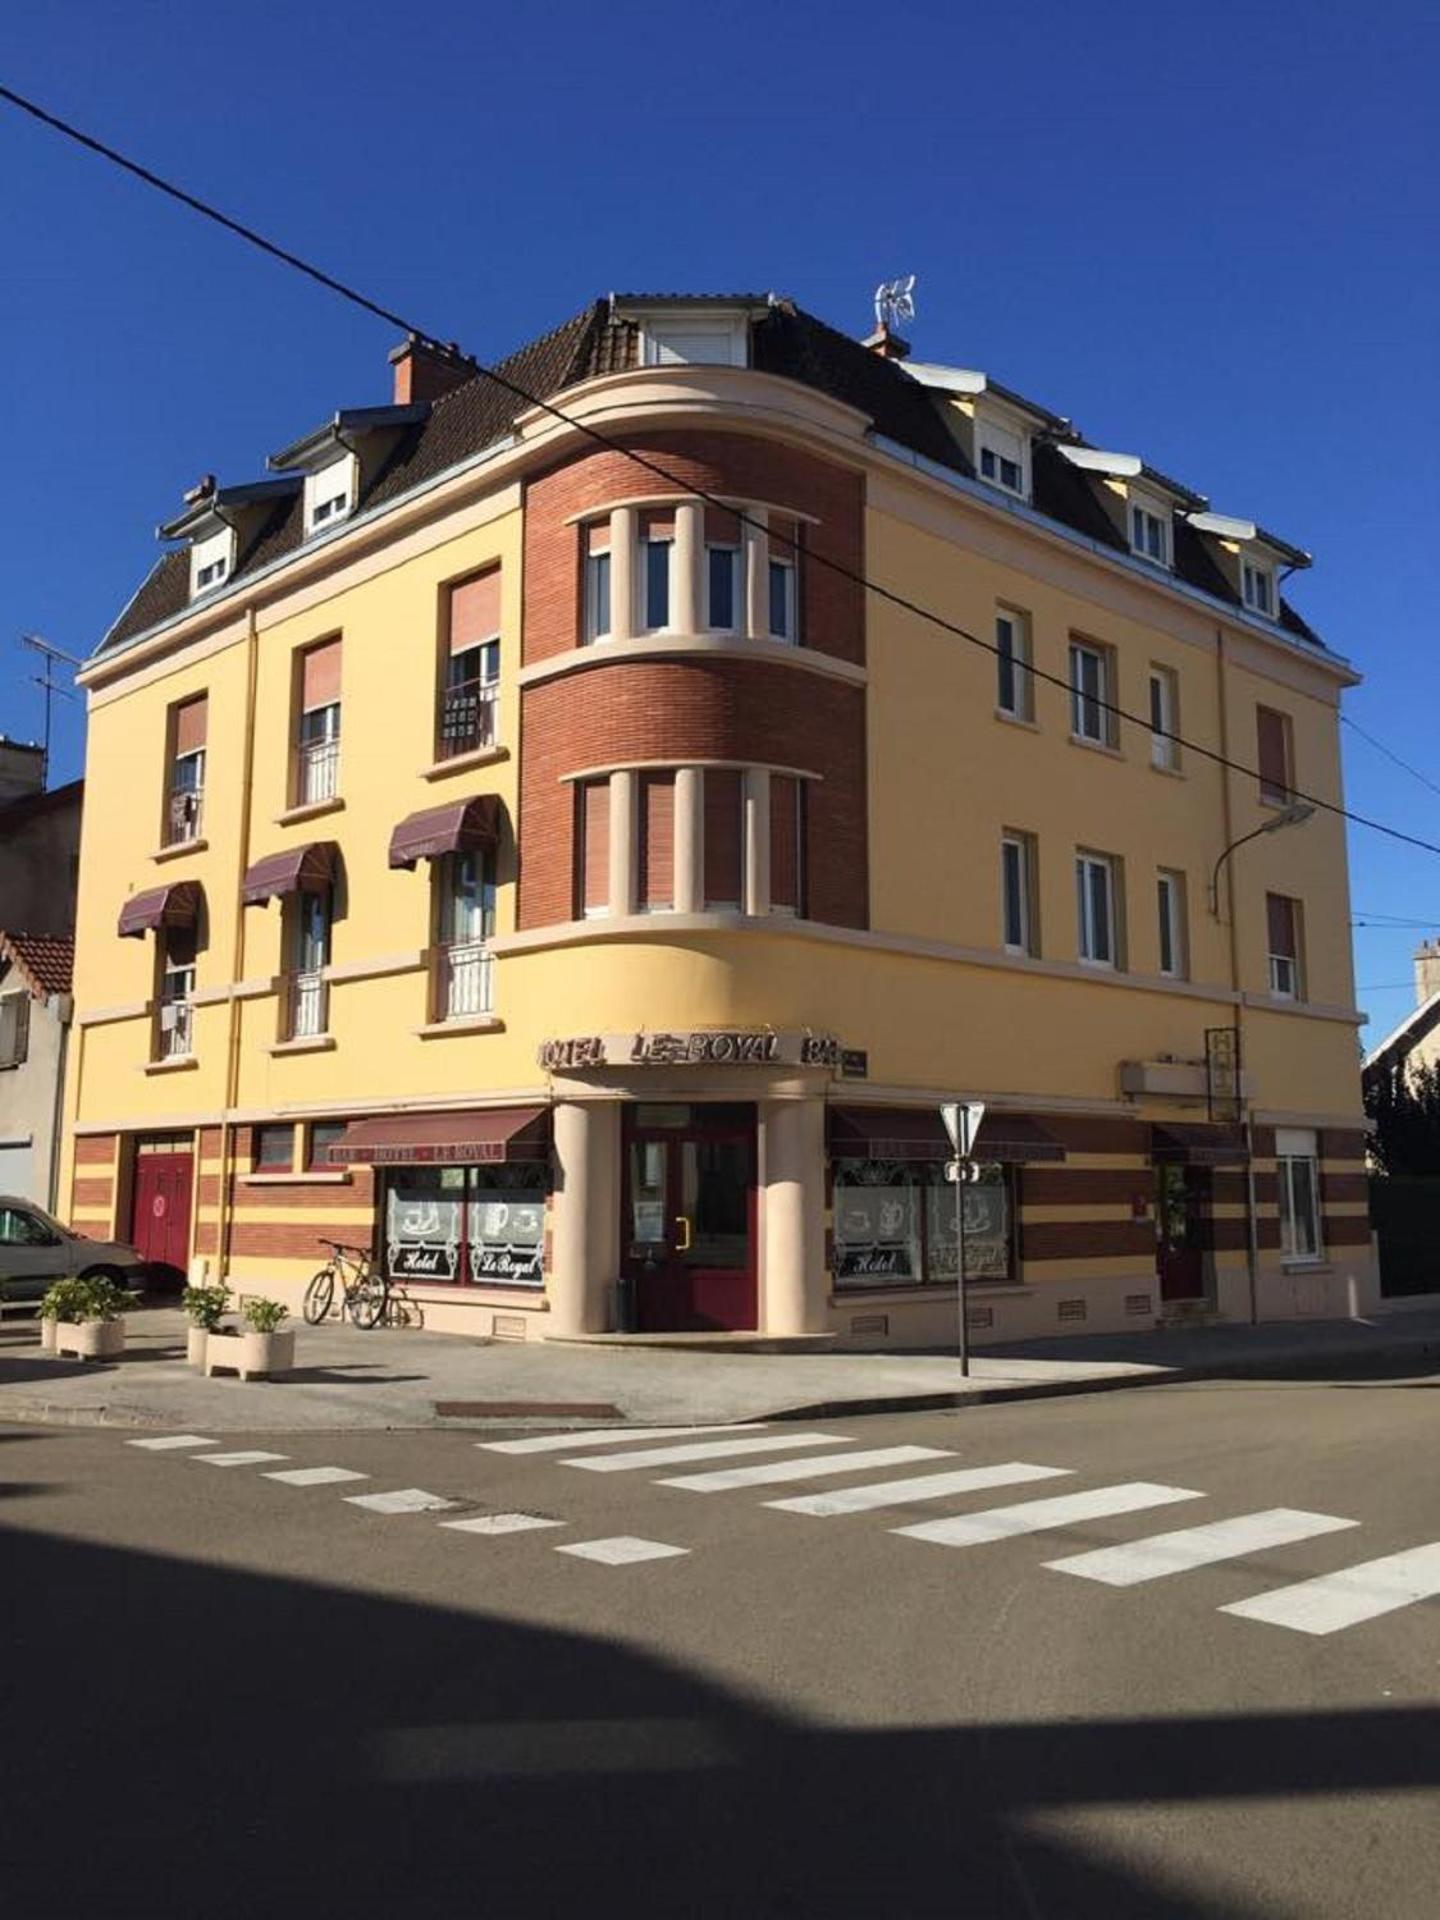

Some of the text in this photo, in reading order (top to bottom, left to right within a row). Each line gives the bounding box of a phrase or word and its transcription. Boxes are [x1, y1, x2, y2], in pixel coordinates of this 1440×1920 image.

[686, 1032, 782, 1062] ROYAL
[376, 1145, 415, 1161] HOTEL
[434, 1145, 453, 1160] LE
[455, 1144, 503, 1160] ROYAL
[403, 1251, 440, 1270] Hotel
[481, 1253, 536, 1280] Le Royal
[853, 1251, 897, 1273] Hotel
